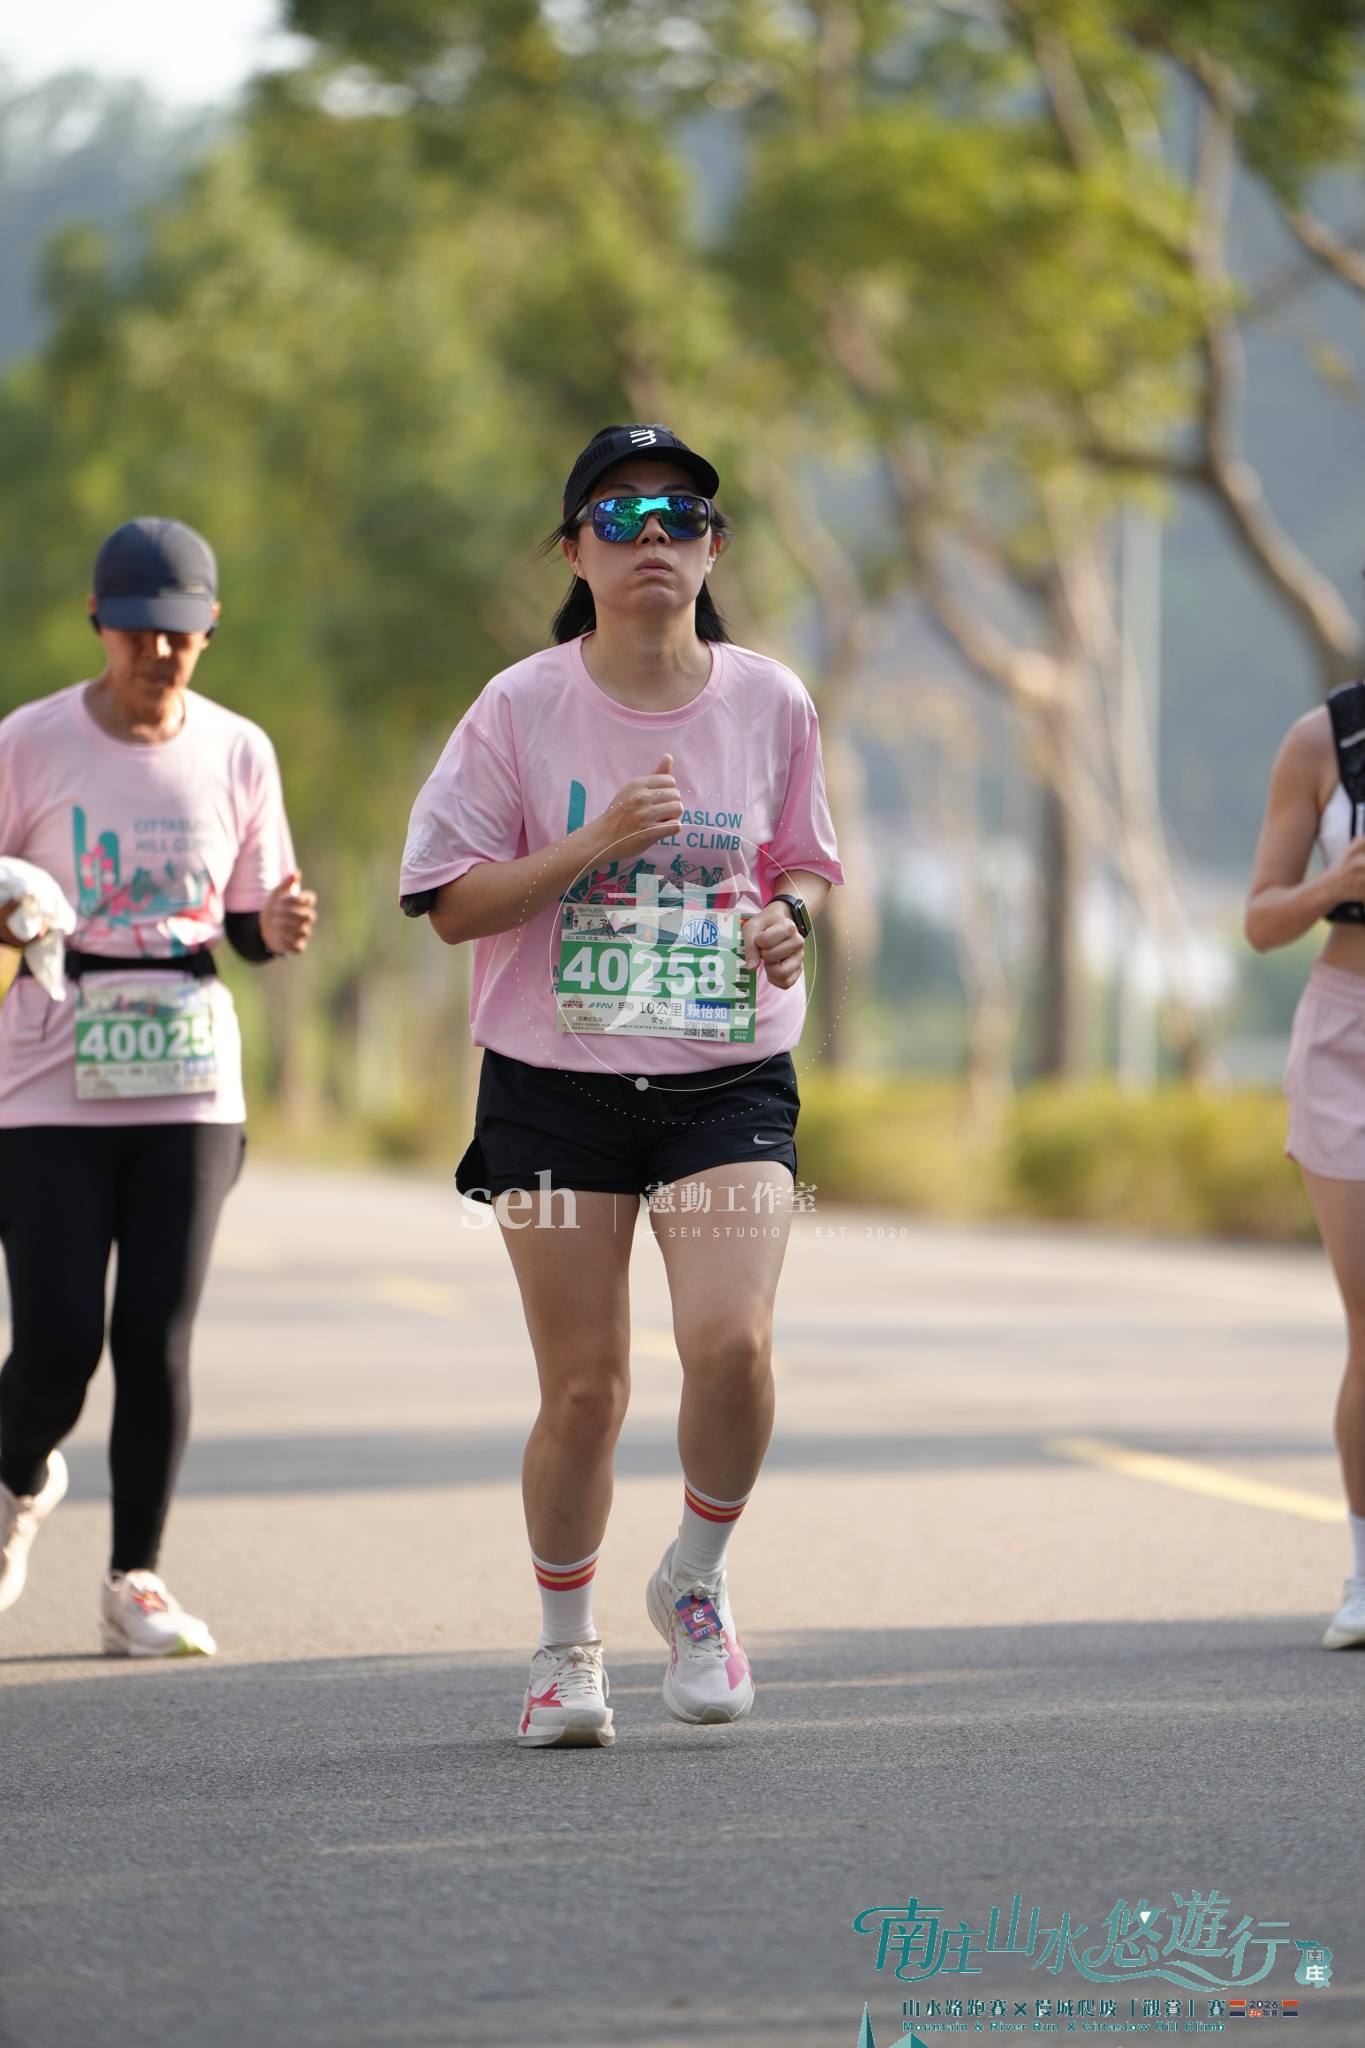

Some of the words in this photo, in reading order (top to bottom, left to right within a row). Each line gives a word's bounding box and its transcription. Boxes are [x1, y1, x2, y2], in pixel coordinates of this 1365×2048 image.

[681, 810, 742, 828] ASLOW
[686, 831, 741, 851] CLIMB
[561, 946, 725, 999] 40258
[686, 1003, 728, 1020] 賴怡如
[79, 1016, 213, 1062] 40025
